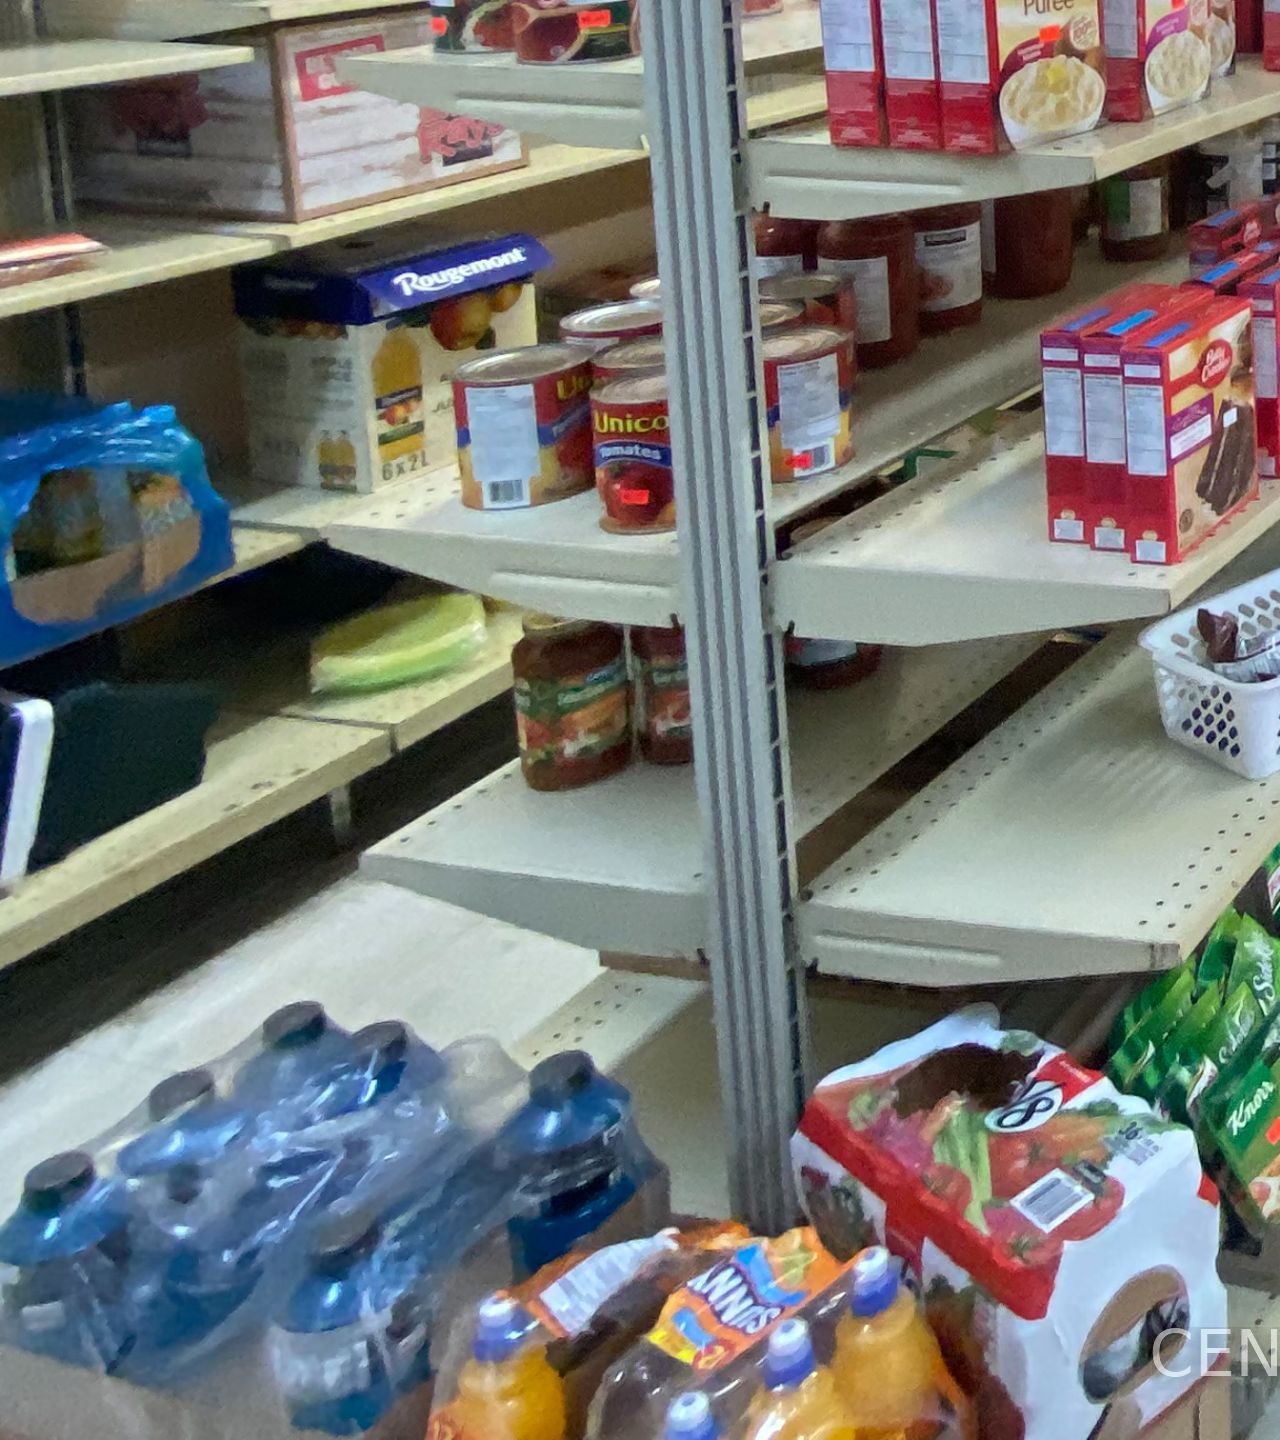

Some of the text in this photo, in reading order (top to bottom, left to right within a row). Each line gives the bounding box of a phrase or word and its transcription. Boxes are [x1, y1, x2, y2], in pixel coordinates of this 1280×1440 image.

[392, 246, 528, 296] Rougemont
[593, 411, 669, 434] Unico
[600, 444, 661, 460] Tomates
[1226, 1080, 1277, 1136] Knorr
